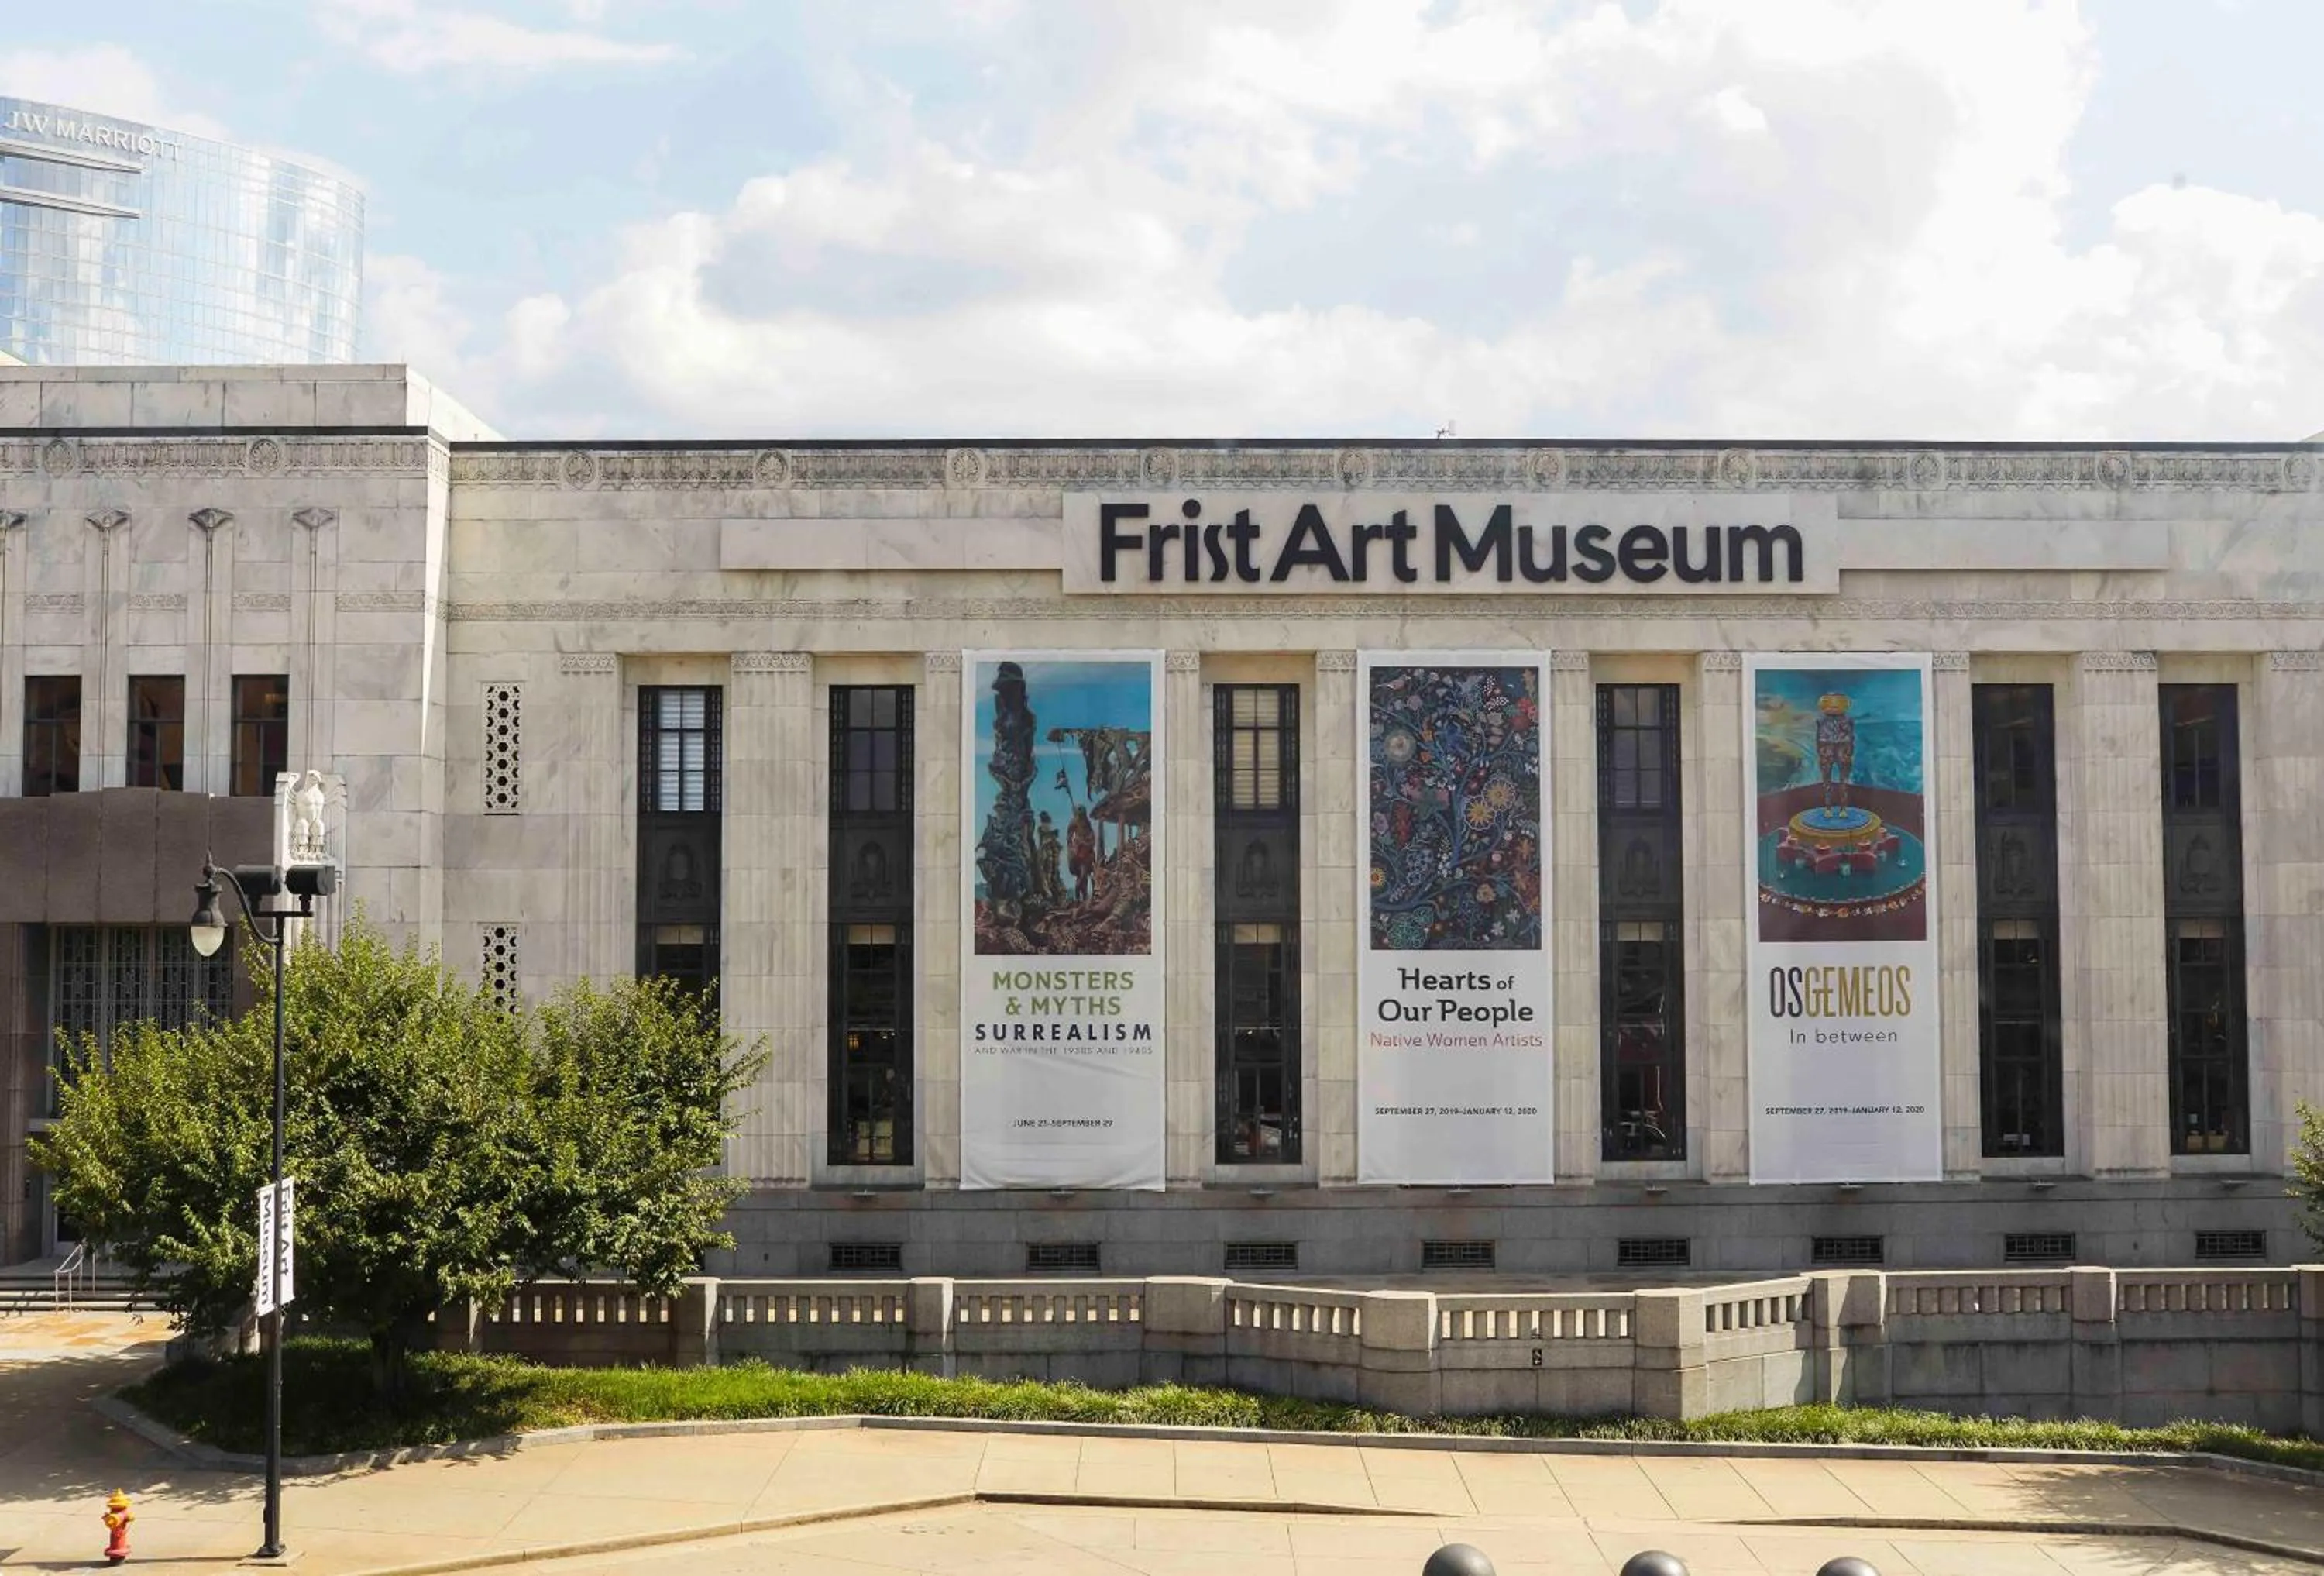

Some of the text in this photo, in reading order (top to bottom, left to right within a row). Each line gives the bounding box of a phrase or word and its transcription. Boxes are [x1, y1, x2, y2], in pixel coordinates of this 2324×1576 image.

[5, 111, 183, 161] JW MARRIOTT
[1100, 498, 1803, 583] Frist Art Museum
[992, 972, 1133, 990] MONSTERS
[1398, 968, 1514, 990] Hearts of
[1770, 966, 1911, 1017] OSGEMEOS
[1005, 996, 1120, 1015] & MYTHS
[1378, 999, 1534, 1027] Our People
[975, 1024, 1151, 1041] SURREALISM
[1370, 1032, 1542, 1047] Native Women Artists
[1789, 1029, 1897, 1044] In between
[975, 1046, 996, 1055] AND
[280, 1240, 290, 1277] Art
